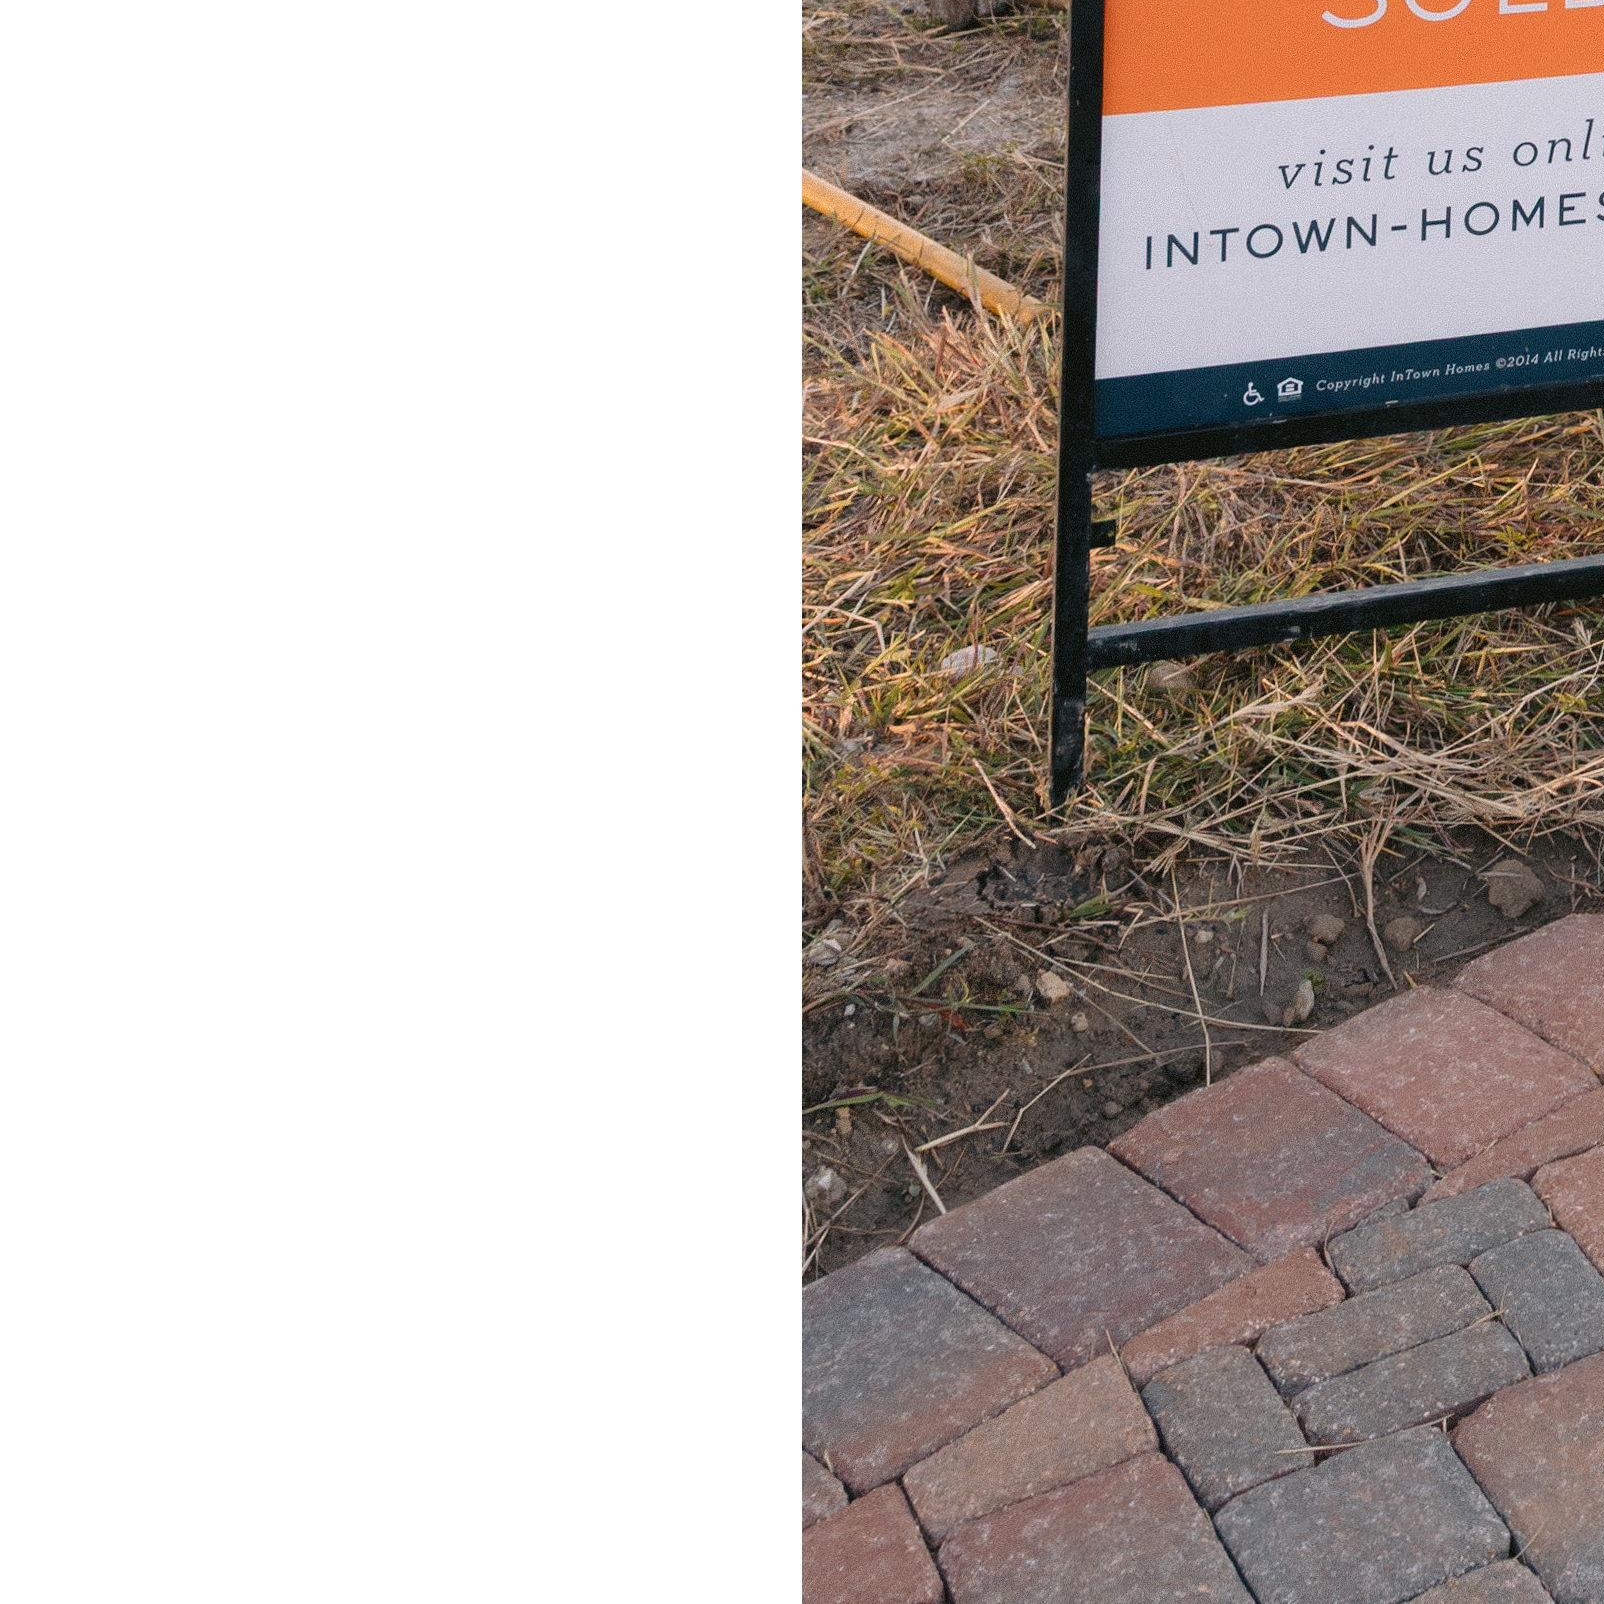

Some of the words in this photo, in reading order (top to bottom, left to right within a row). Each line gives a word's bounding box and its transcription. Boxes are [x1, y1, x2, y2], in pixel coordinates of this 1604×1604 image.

[1276, 144, 1400, 191] visit
[1426, 146, 1486, 178] us
[1316, 373, 1386, 392] Copyright
[1390, 368, 1440, 383] InTown
[1444, 362, 1491, 376] Homes
[1495, 353, 1540, 369] ©2014
[1543, 350, 1563, 363] All
